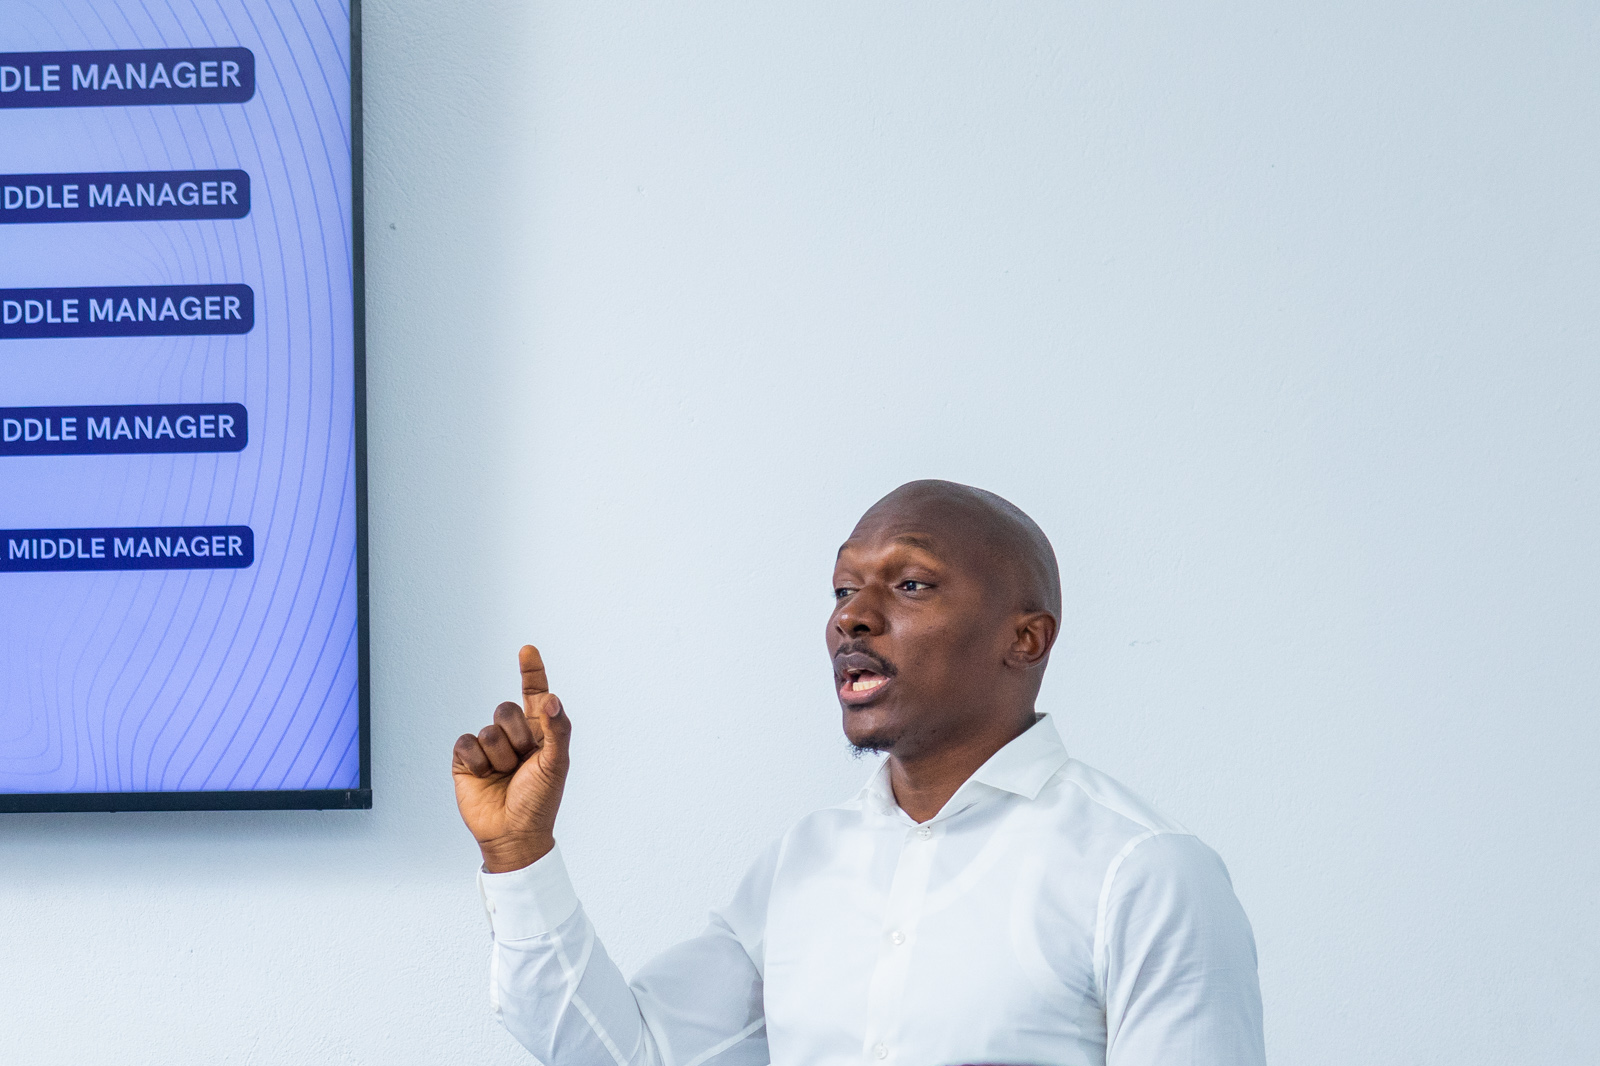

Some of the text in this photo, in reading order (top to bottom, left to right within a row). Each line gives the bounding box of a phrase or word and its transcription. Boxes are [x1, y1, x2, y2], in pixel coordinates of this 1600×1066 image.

[72, 61, 242, 91] MANAGER
[88, 182, 239, 208] MANAGER
[89, 296, 242, 322] MANAGER
[87, 414, 236, 440] MANAGER
[8, 538, 106, 560] MIDDLE
[113, 535, 244, 558] MANAGER
